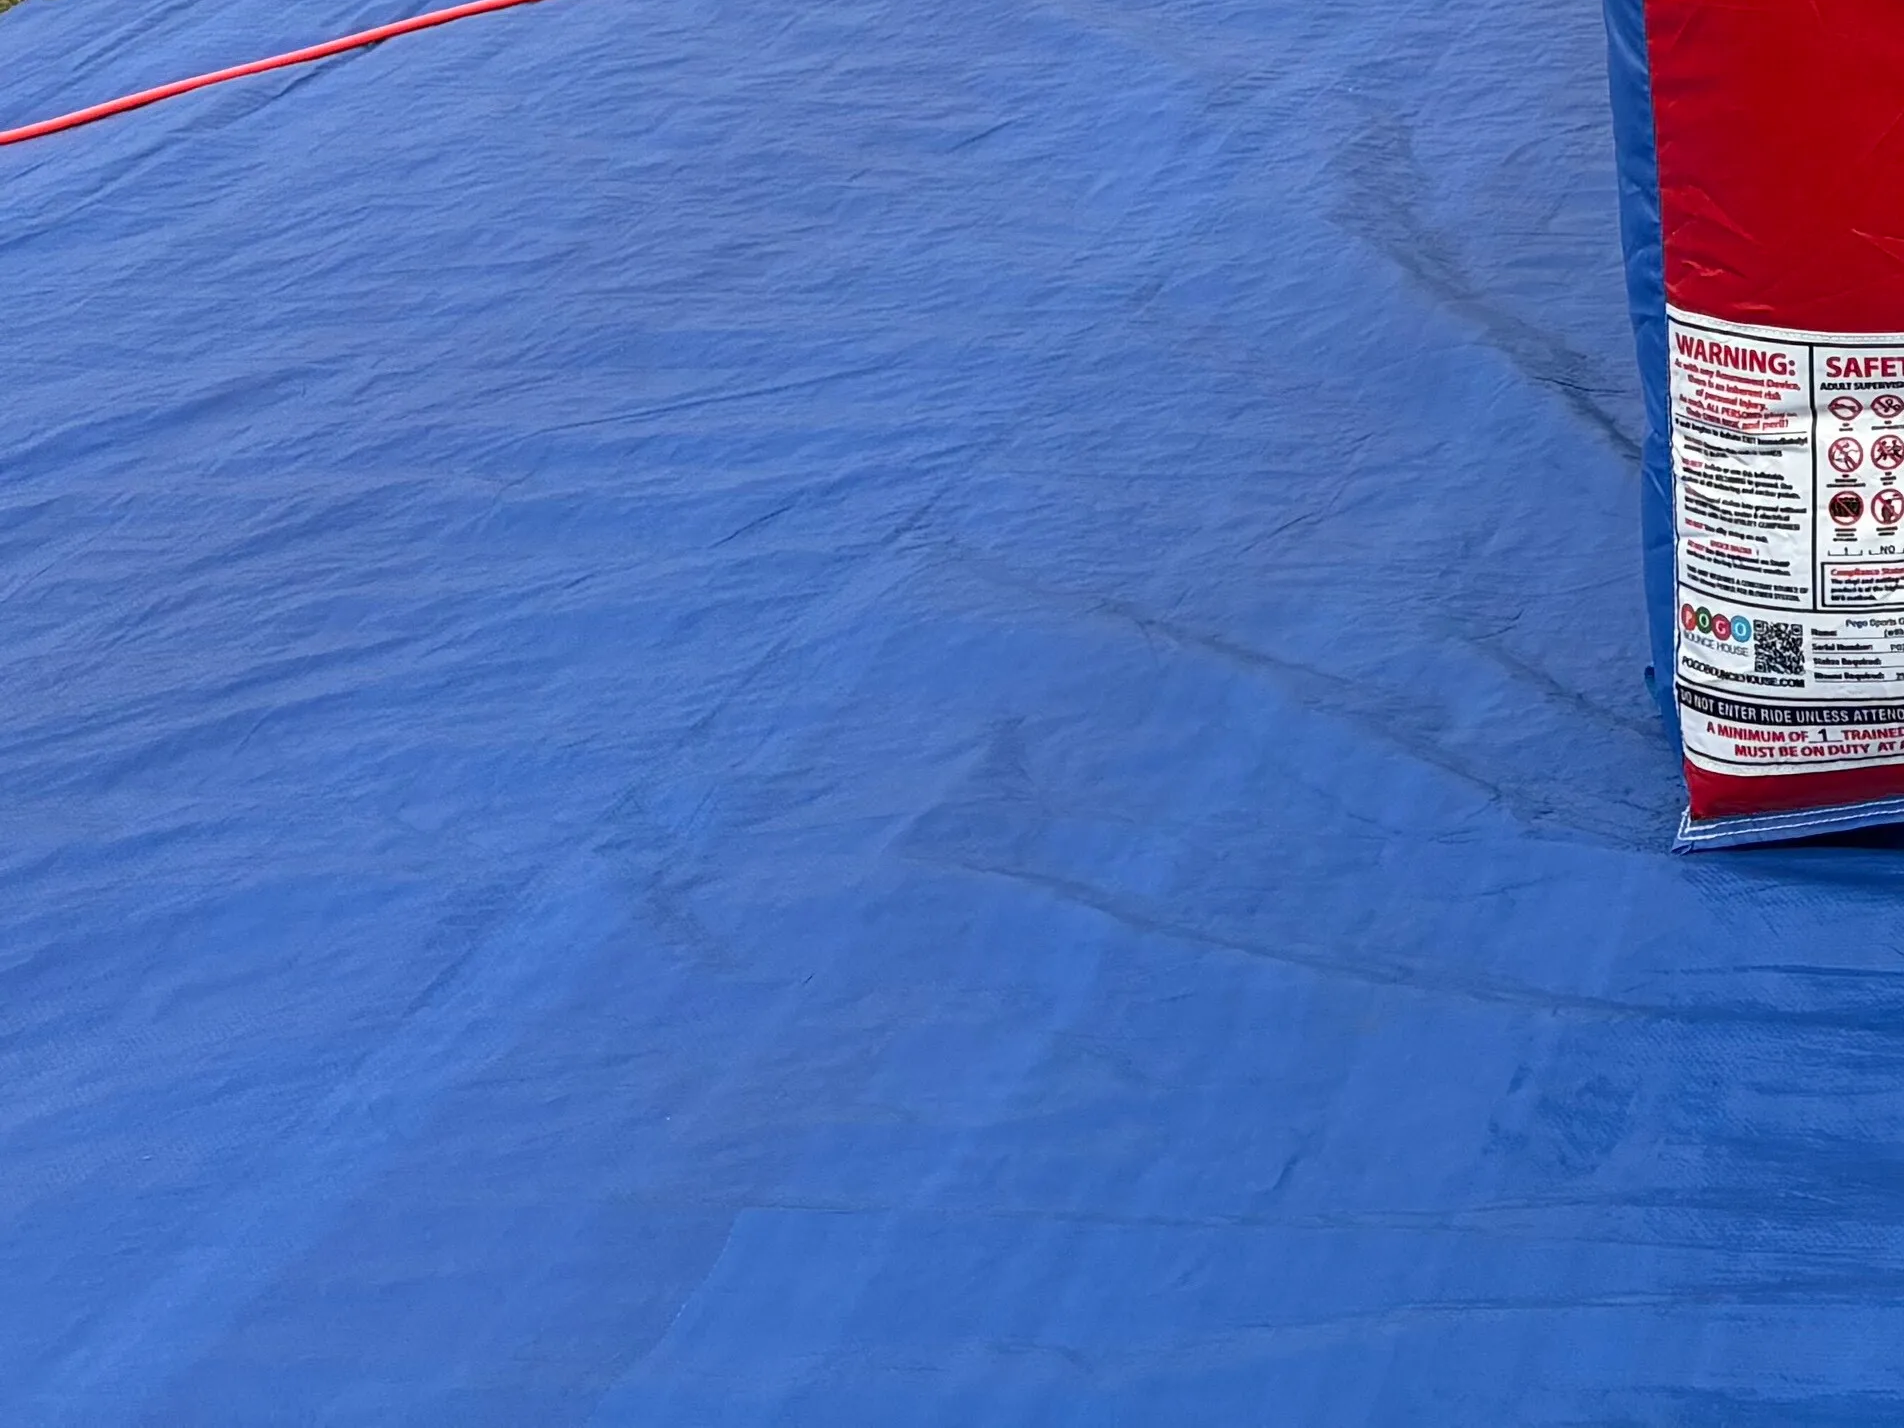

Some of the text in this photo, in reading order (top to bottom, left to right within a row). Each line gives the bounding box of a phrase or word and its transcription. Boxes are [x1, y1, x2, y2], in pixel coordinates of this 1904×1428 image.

[1675, 331, 1796, 376] WARNING:
[1684, 606, 1749, 638] POGO
[1717, 642, 1749, 657] HOUSE
[1681, 689, 1692, 705] DO
[1694, 695, 1714, 713] NOT
[1718, 703, 1757, 721] ENTER
[1760, 708, 1792, 723] RIDE
[1796, 709, 1849, 723] UNLESS
[1706, 721, 1715, 735] A
[1717, 723, 1785, 743] MINIMUM
[1788, 731, 1809, 743] OF
[1818, 728, 1828, 742] 1
[1735, 744, 1775, 758] MUST
[1778, 745, 1798, 757] BE
[1801, 744, 1825, 757] ON
[1828, 743, 1869, 756] DUTY
[1878, 741, 1896, 753] AT
